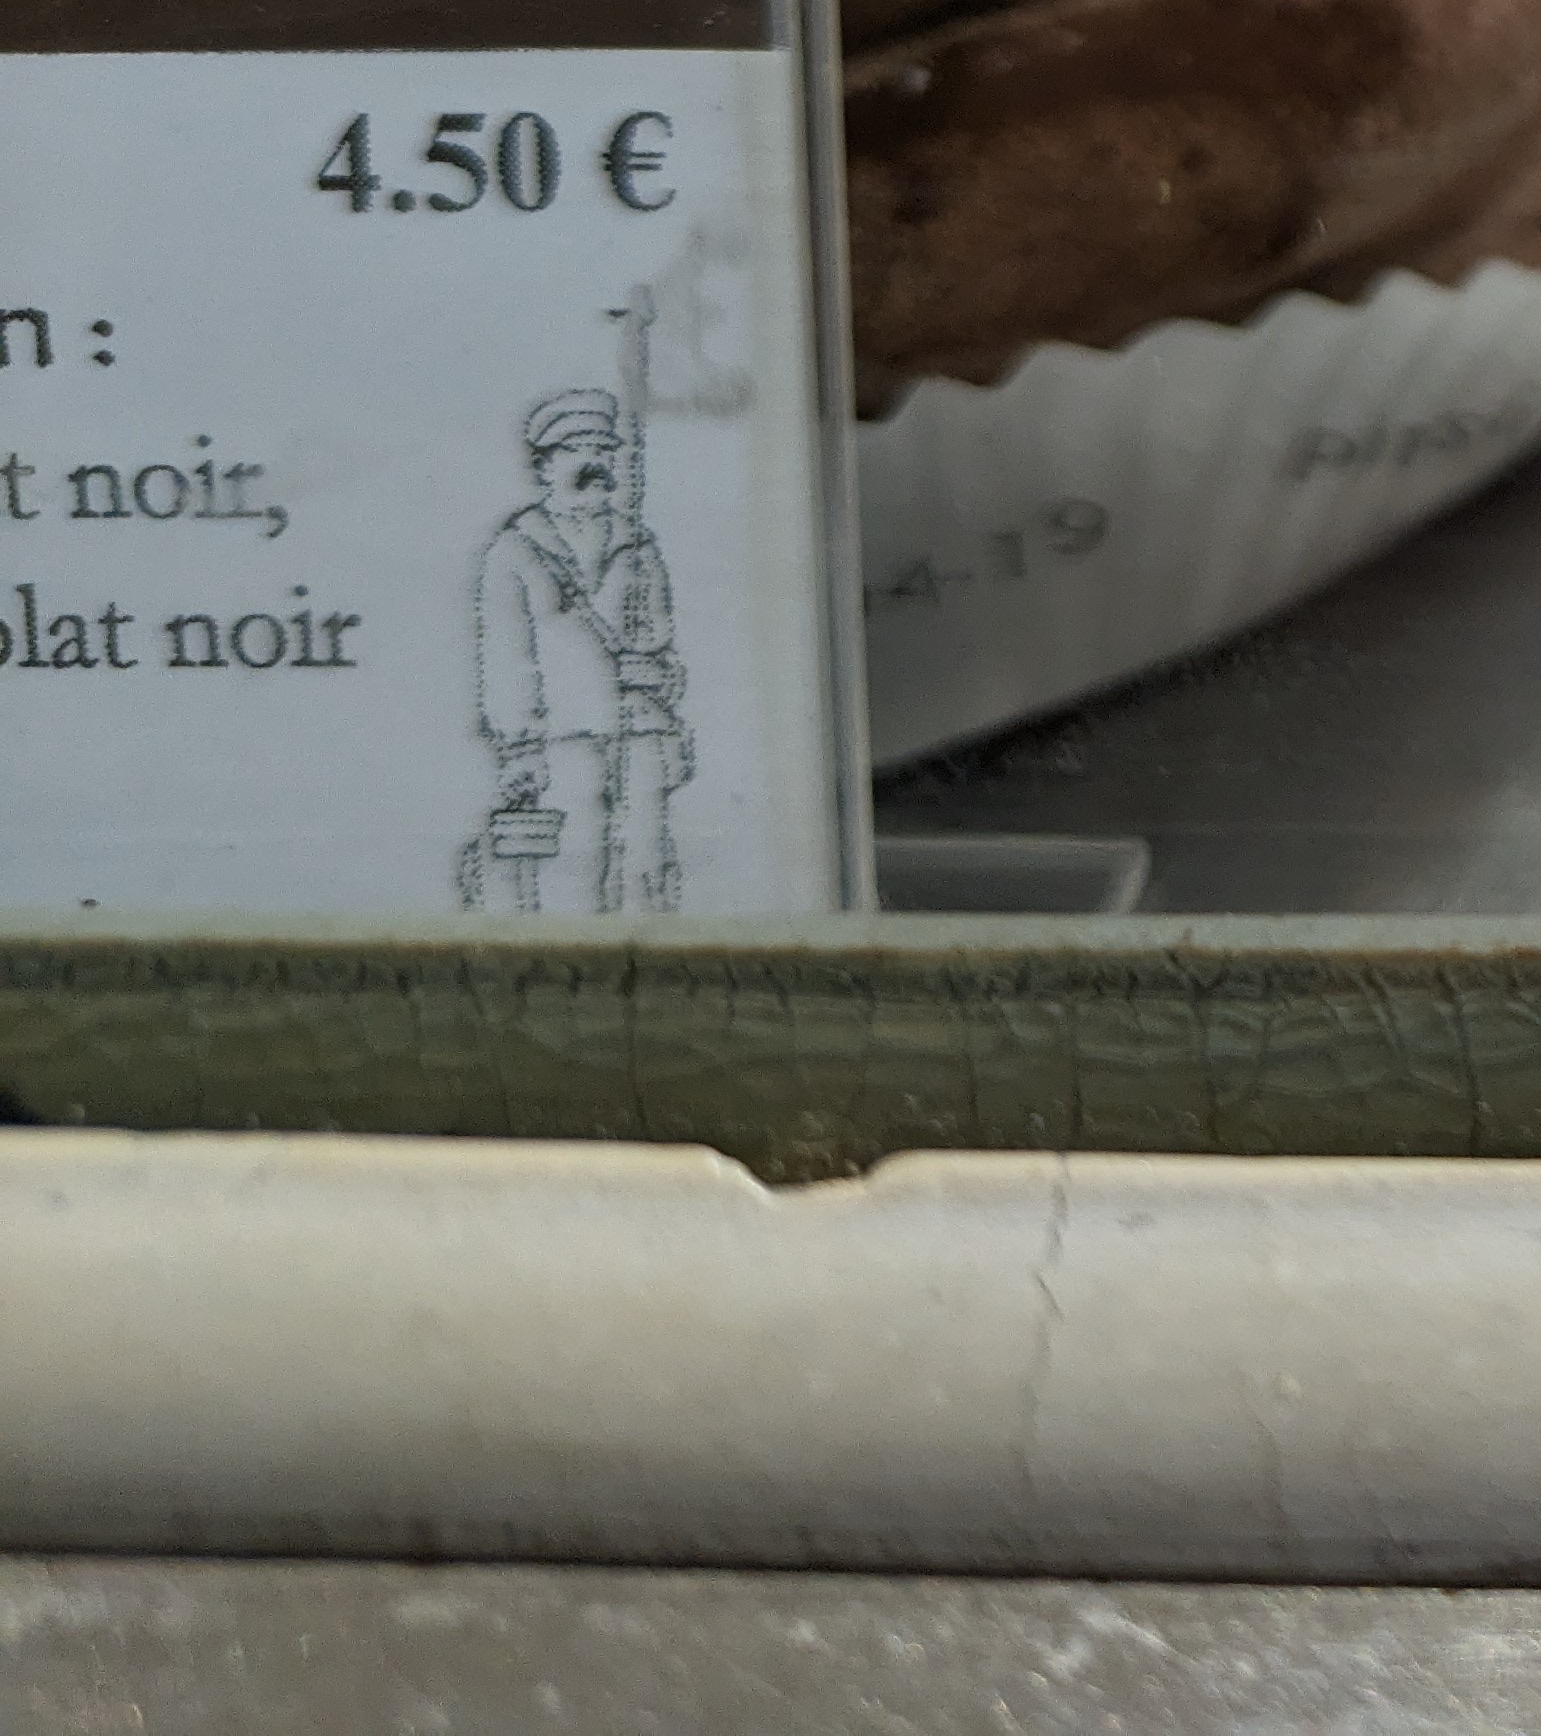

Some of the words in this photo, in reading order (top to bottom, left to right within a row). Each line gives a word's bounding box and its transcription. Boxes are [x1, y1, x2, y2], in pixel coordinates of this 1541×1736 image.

[313, 110, 563, 214] 4.50
[598, 109, 677, 214] €
[66, 434, 289, 539] noir,
[0, 582, 139, 670] lat
[163, 584, 363, 670] noir
